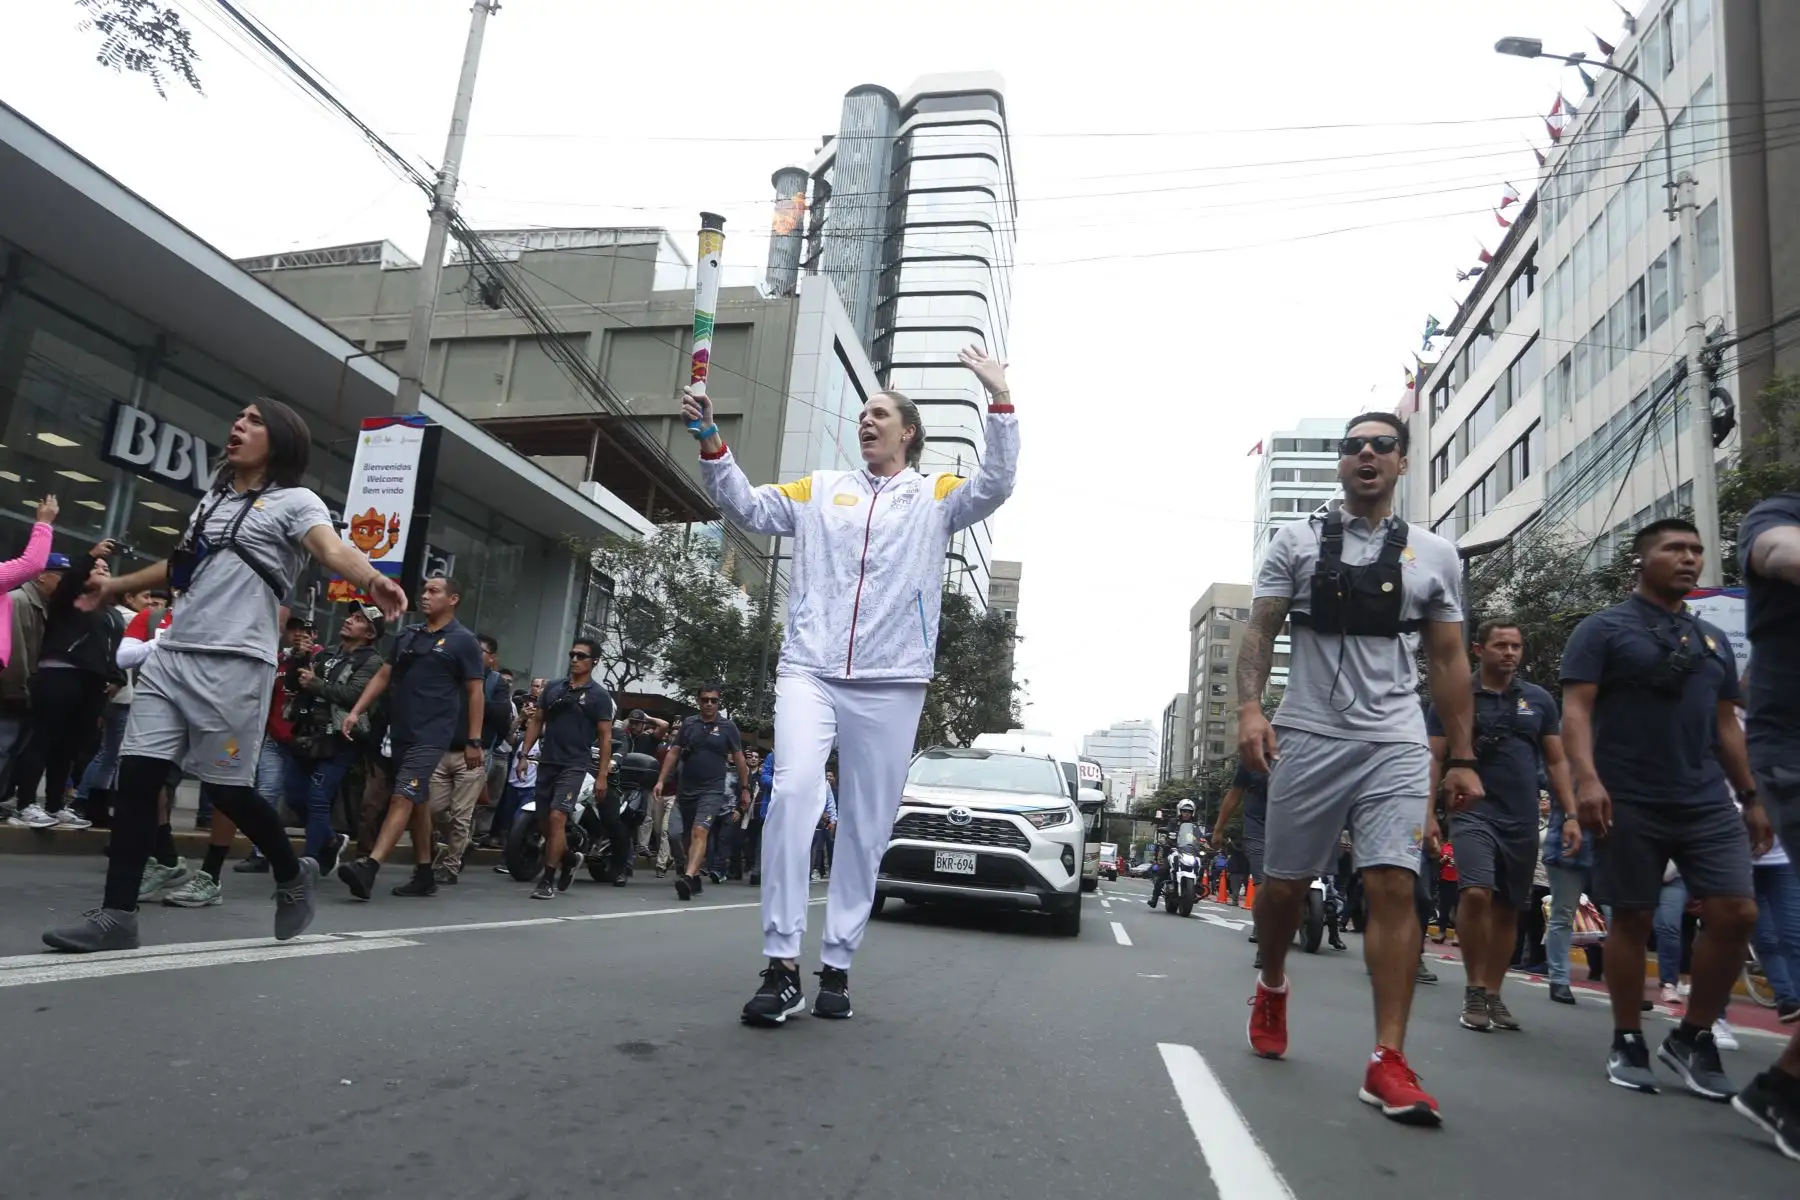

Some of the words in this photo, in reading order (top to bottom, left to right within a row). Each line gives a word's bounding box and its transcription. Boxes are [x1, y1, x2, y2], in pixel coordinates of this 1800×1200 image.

[109, 404, 222, 492] BBV
[363, 463, 412, 471] Bienvenidos
[367, 475, 404, 483] Welcome
[362, 486, 380, 495] Bem
[381, 486, 404, 495] vindo
[936, 856, 974, 871] BKR-694
